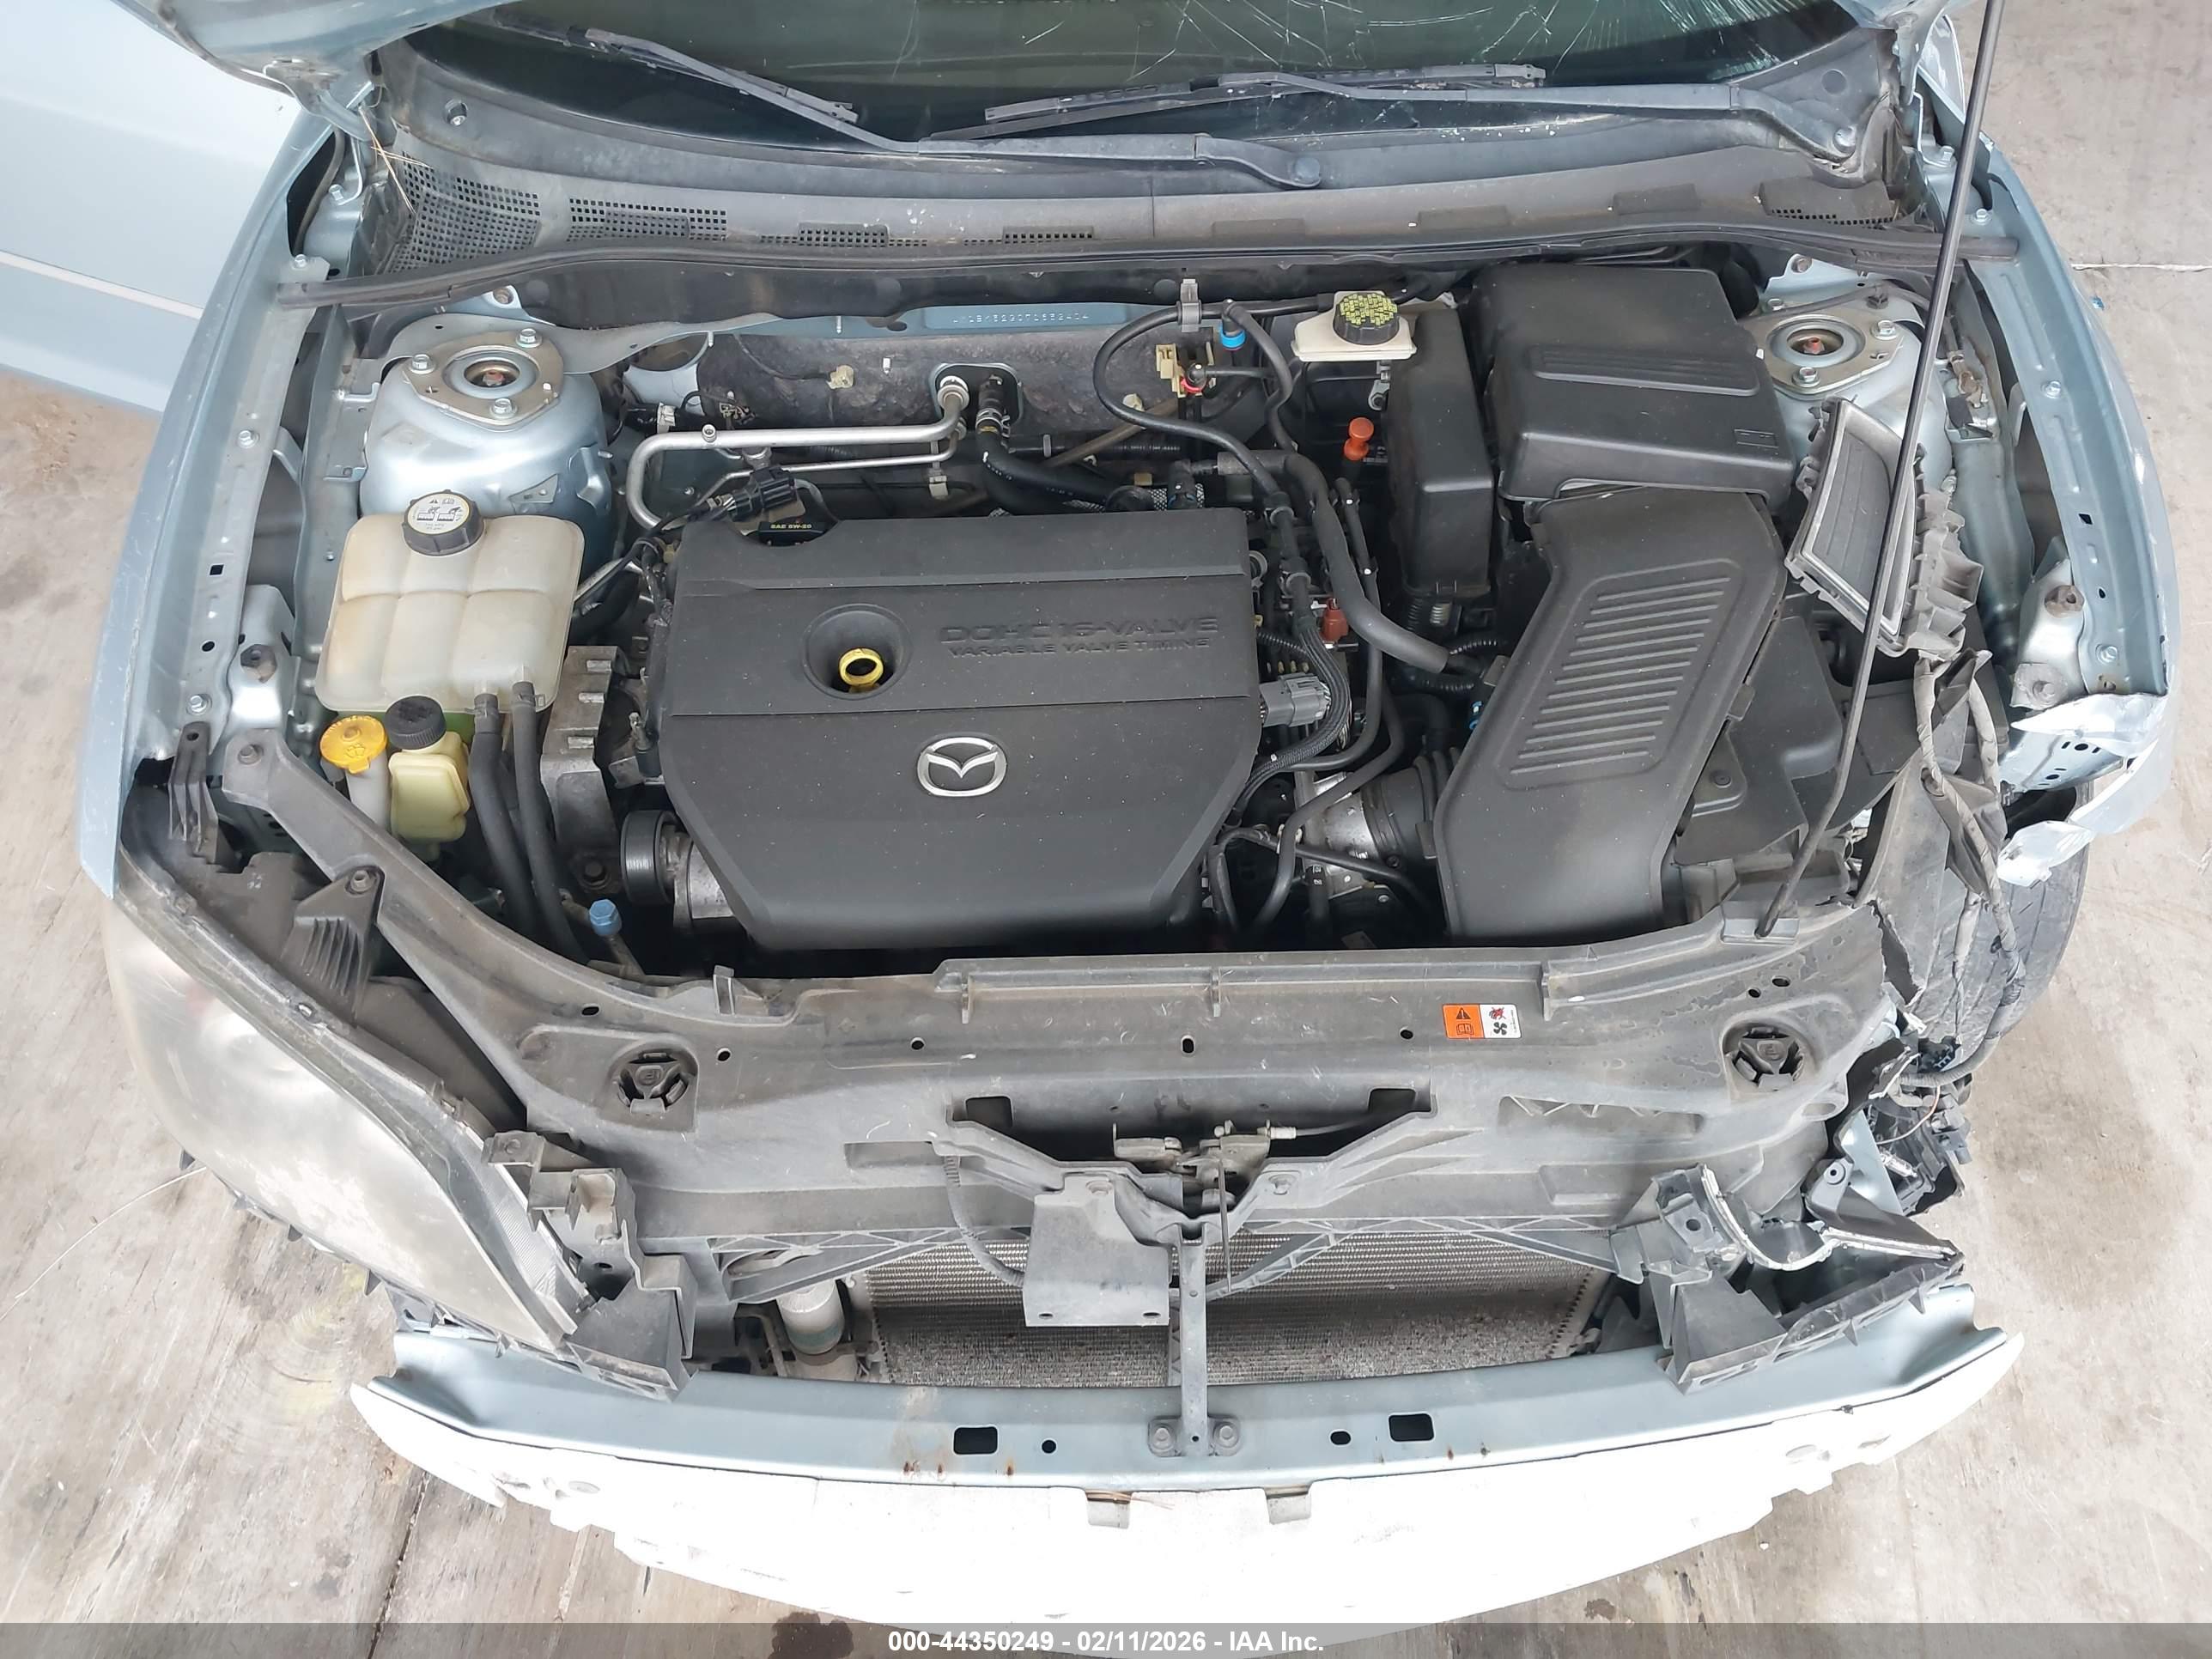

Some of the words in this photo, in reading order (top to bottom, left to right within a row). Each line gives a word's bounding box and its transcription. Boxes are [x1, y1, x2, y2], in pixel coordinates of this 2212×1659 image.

[941, 624, 1052, 643] DOHC
[1057, 617, 1218, 639] 16-VALVE
[947, 644, 1057, 658] VARIABLE
[1061, 641, 1129, 653] VALVE
[1133, 637, 1210, 652] TIMING
